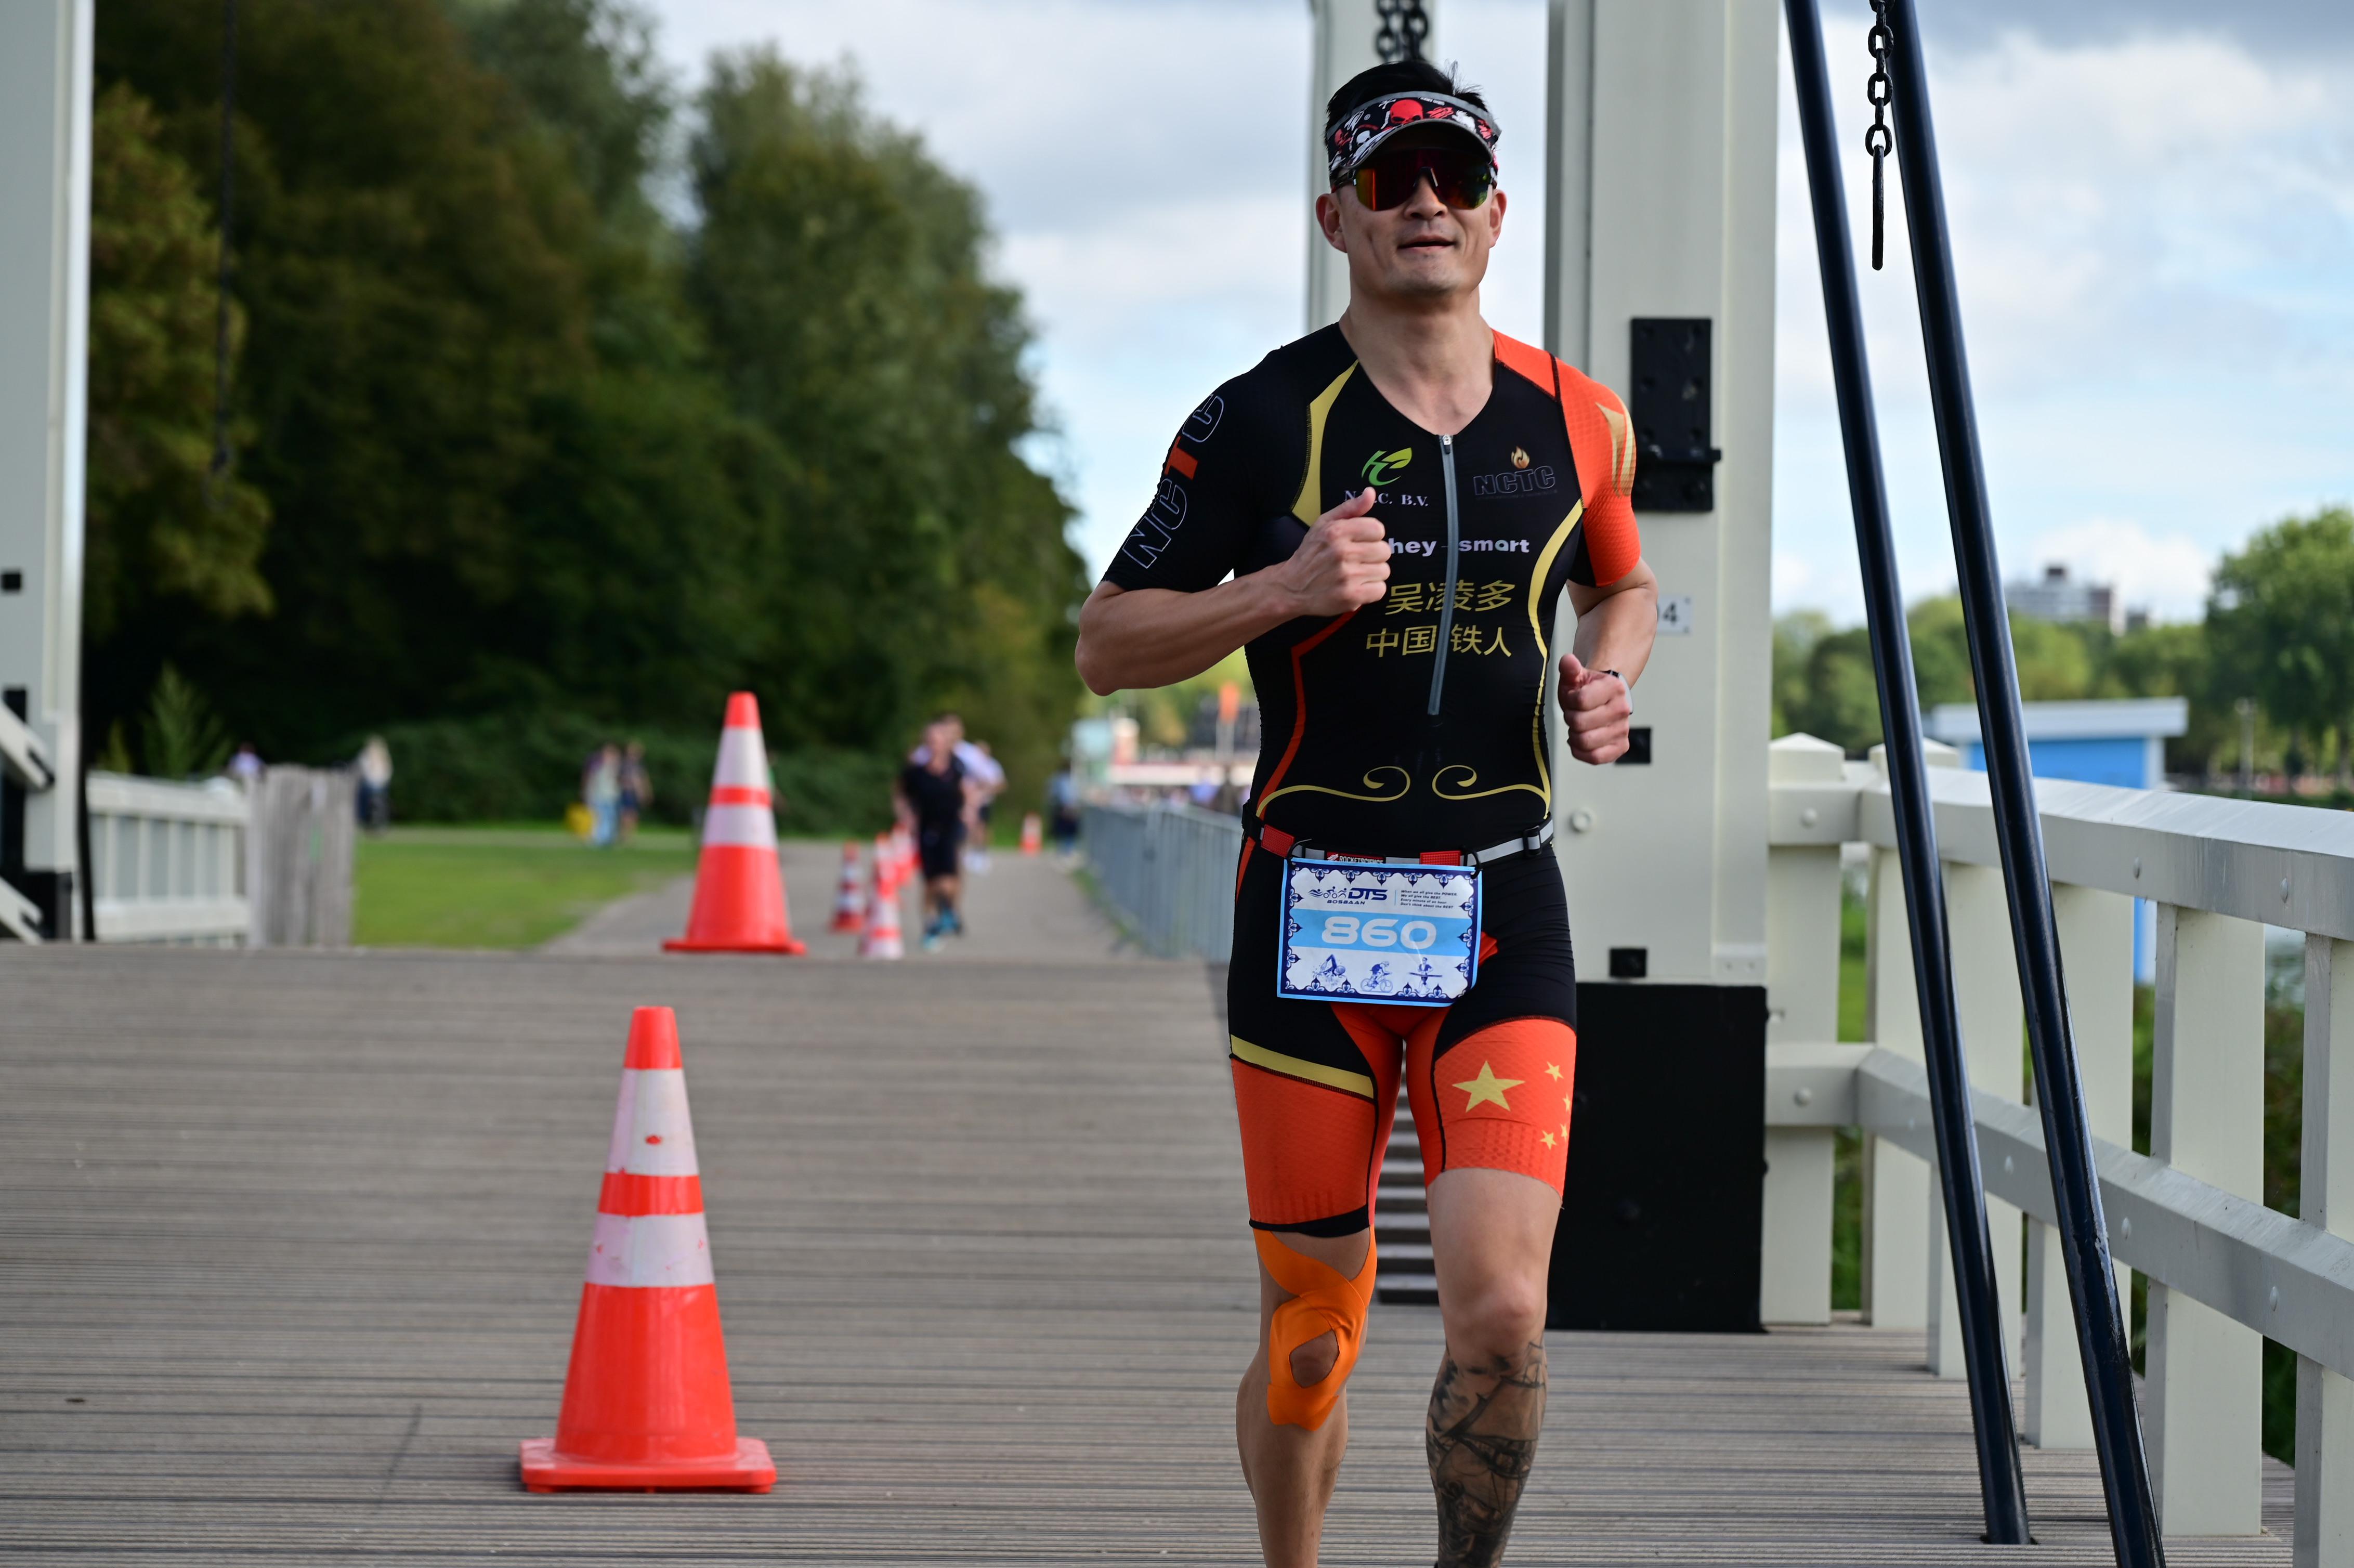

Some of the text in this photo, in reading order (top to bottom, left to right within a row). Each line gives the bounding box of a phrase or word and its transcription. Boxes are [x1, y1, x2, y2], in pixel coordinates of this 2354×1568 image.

[1121, 394, 1224, 569] NCTC
[1473, 465, 1556, 495] NCTC
[1401, 494, 1429, 507] B.V.
[1458, 539, 1529, 553] smart
[1365, 623, 1512, 658] 中国铁人
[1348, 887, 1388, 900] DTS
[1321, 916, 1437, 950] 860
